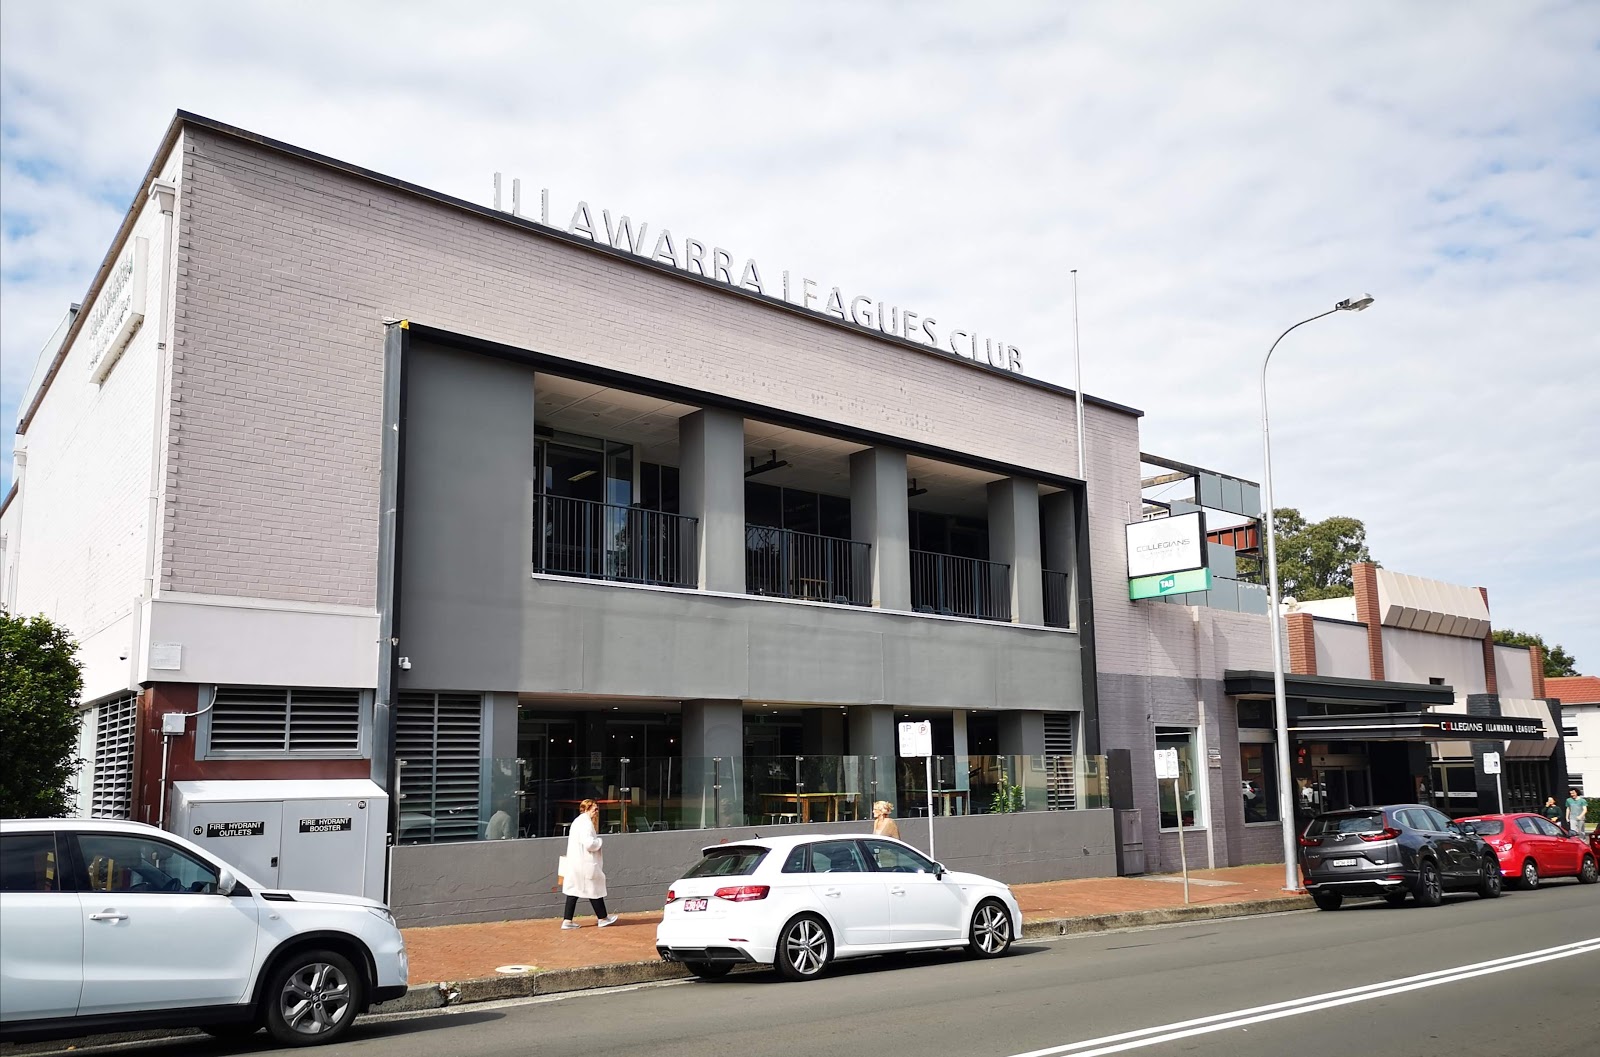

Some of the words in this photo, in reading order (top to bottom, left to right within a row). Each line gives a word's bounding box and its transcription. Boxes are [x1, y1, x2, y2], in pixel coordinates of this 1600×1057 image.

[493, 171, 766, 296] ILLAWARRA
[782, 270, 938, 348] LEAGUES
[949, 329, 1025, 374] CLUB
[1136, 538, 1191, 553] COLLEGIANS
[1160, 579, 1174, 588] TAB
[1440, 721, 1483, 732] COLLEGIANS
[1485, 723, 1514, 733] ILLAWARRA
[1515, 725, 1538, 734] LEAGUES
[301, 818, 316, 826] FIRE
[318, 818, 350, 826] HYDRANT
[219, 829, 252, 837] OUTLETS
